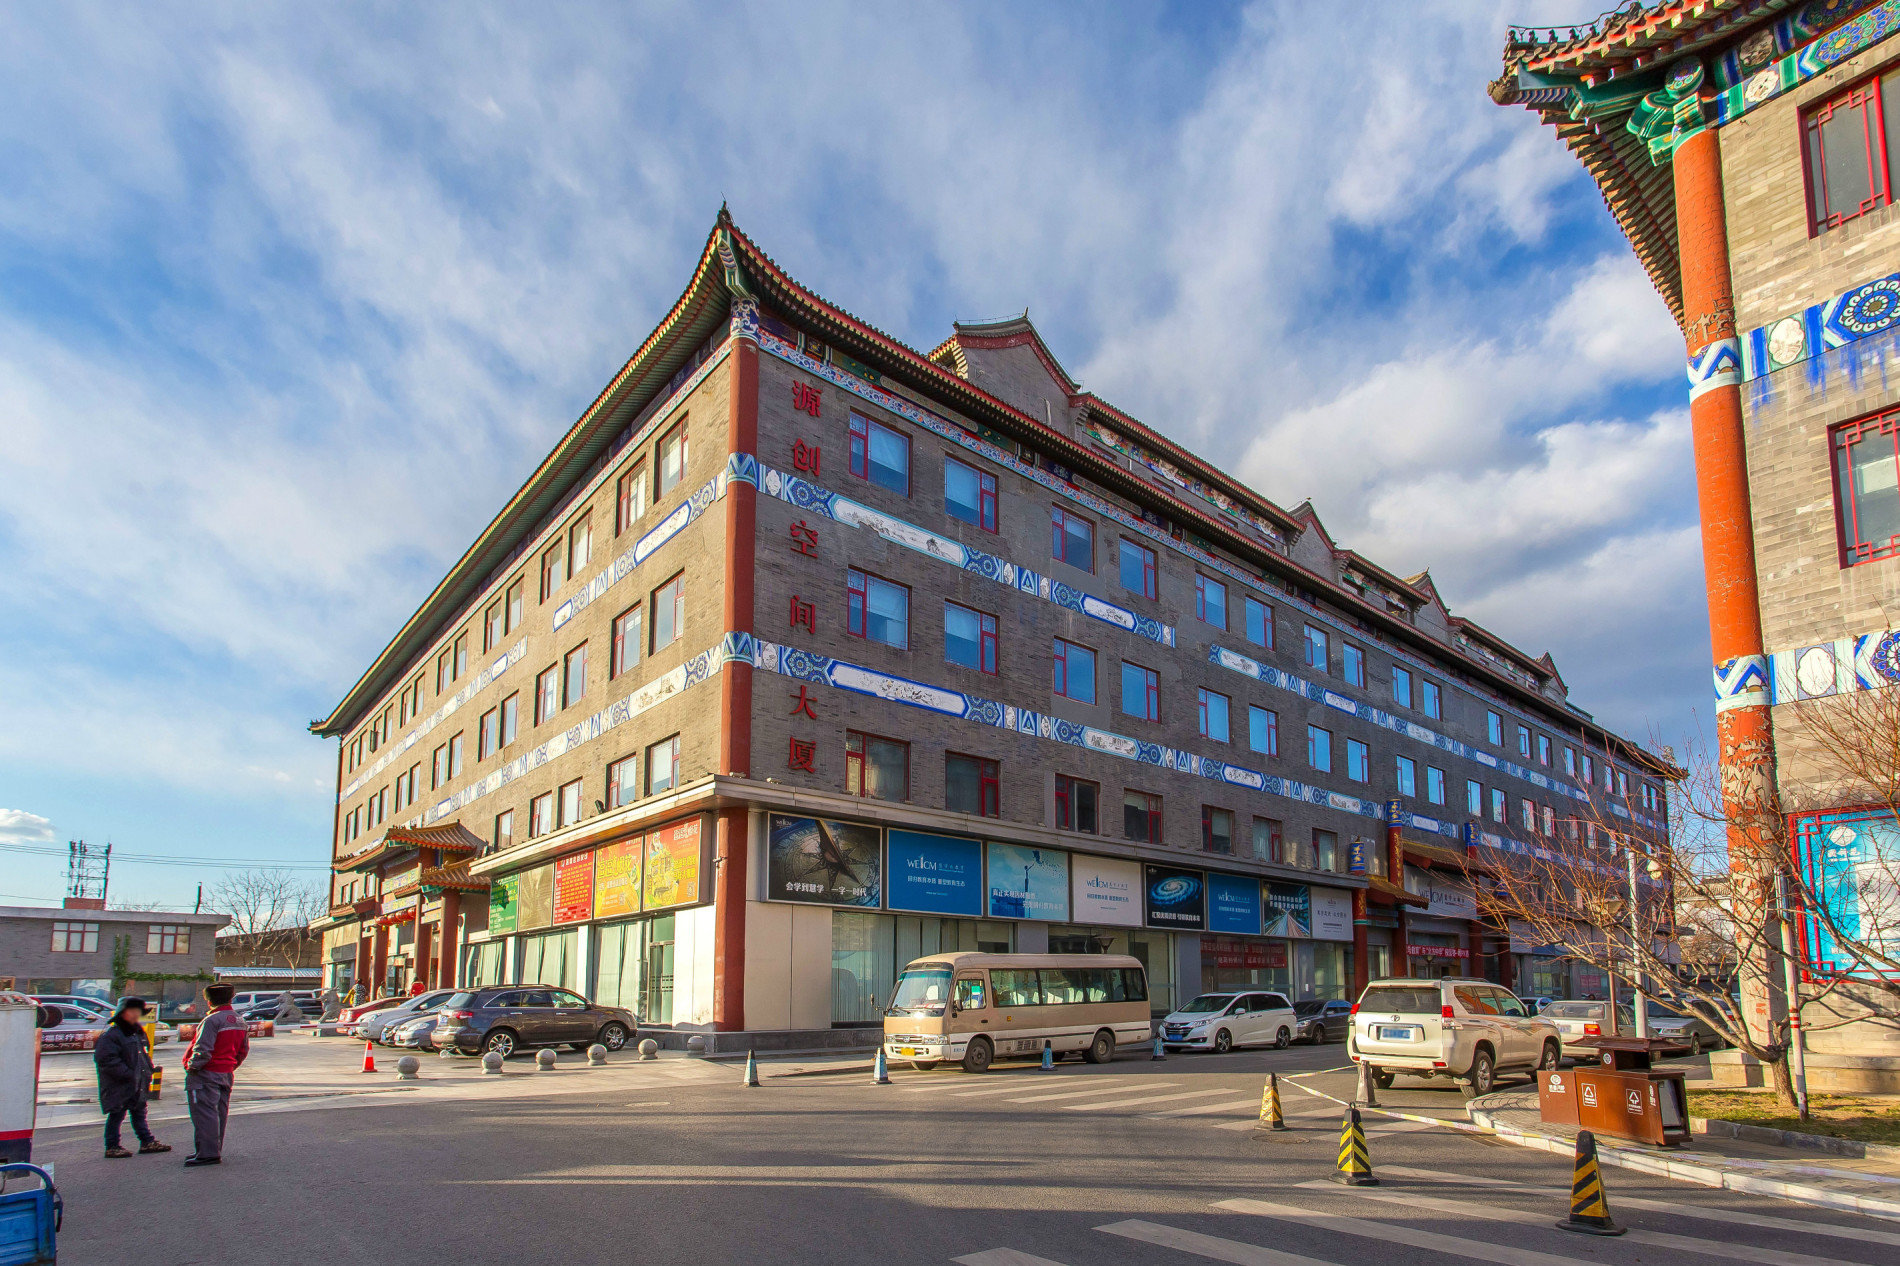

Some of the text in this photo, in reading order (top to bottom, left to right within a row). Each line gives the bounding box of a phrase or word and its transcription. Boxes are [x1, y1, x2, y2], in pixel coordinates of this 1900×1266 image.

[789, 379, 821, 774] 源创空间大厦
